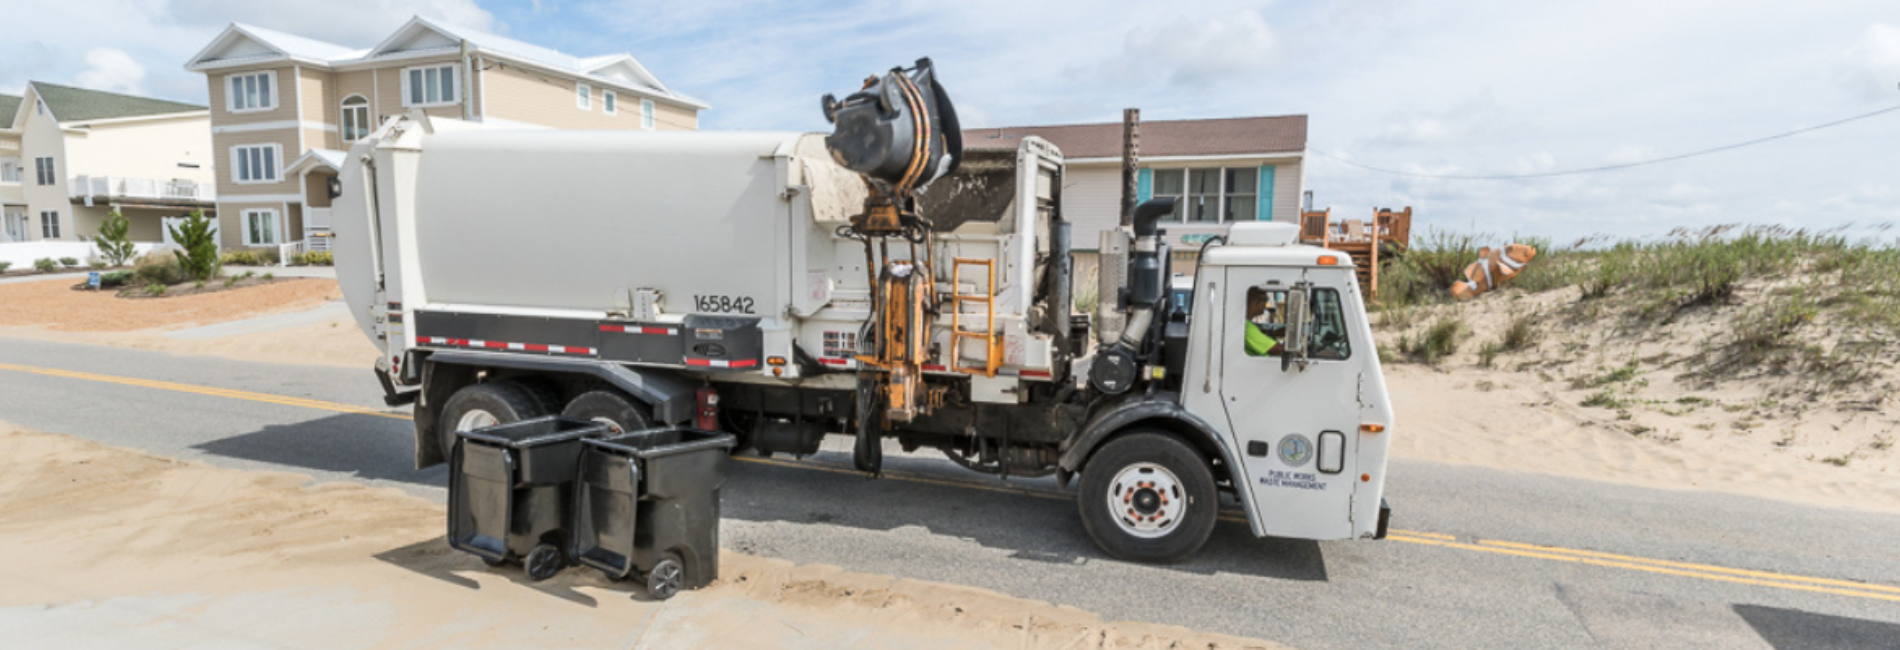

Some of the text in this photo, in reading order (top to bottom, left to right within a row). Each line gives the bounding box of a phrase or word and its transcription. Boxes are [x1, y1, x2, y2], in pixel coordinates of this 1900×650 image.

[694, 295, 756, 314] 165842
[1269, 469, 1315, 481] PUBLIC WORKS
[1260, 477, 1327, 490] WASTE MANAGEMENT
